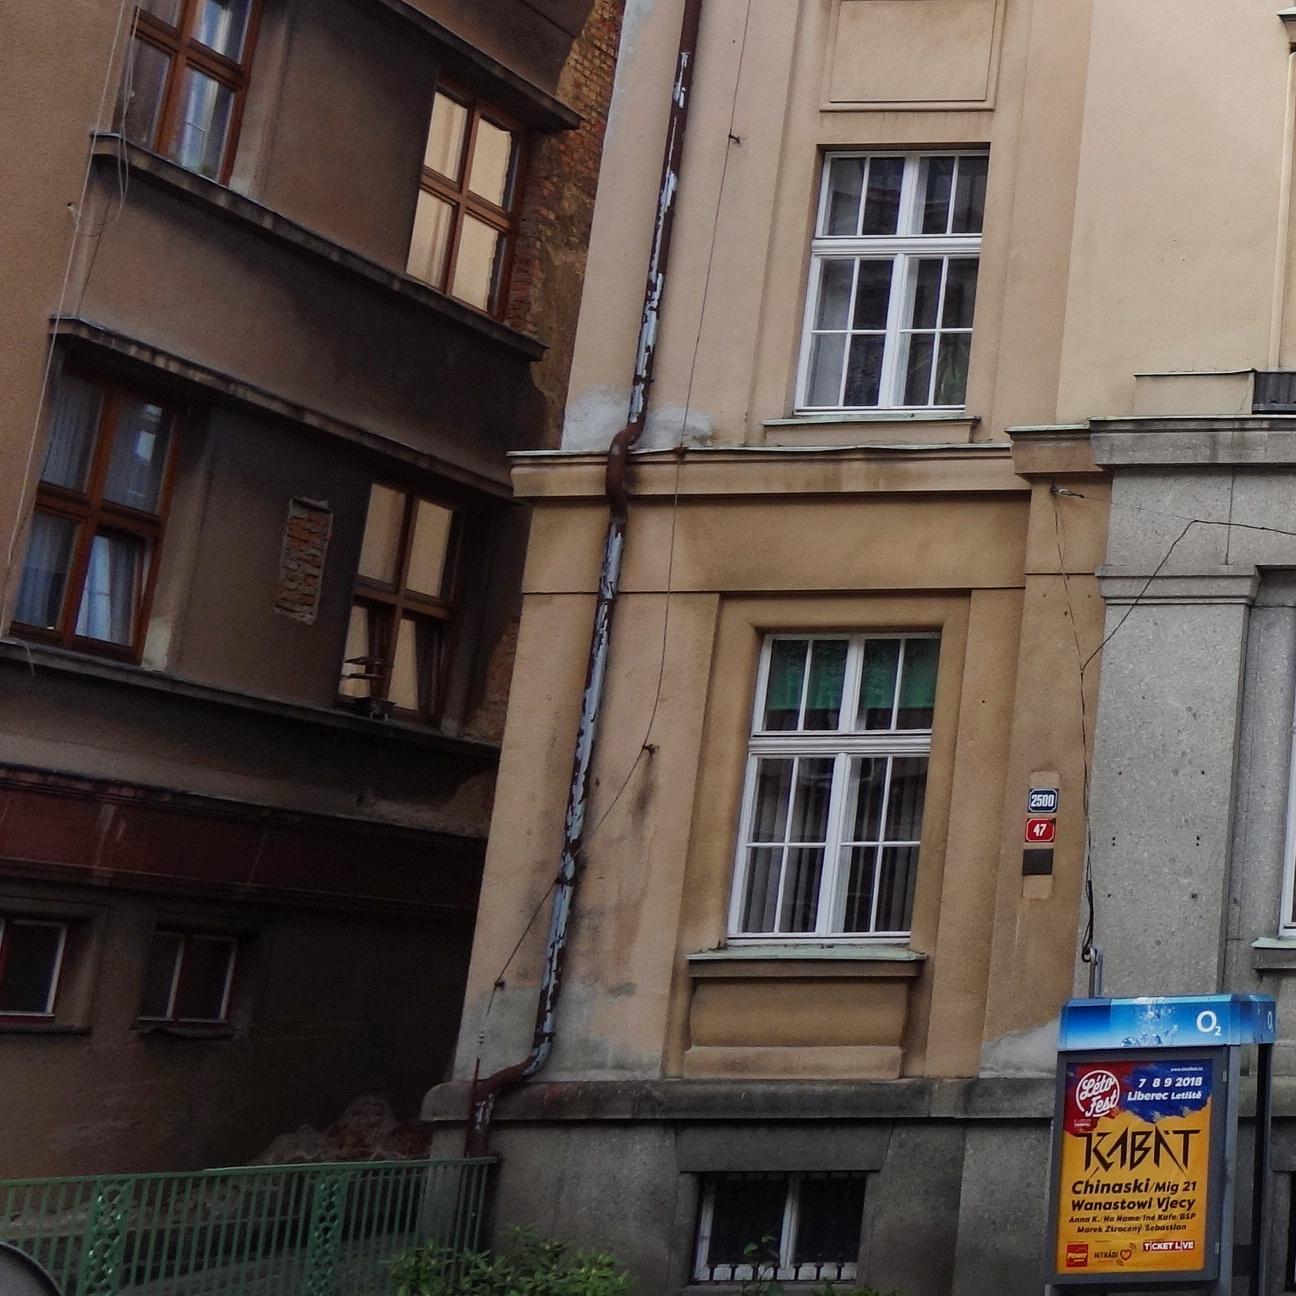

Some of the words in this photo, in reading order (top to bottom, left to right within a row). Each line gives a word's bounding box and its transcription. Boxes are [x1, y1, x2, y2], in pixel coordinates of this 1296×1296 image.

[1030, 794, 1054, 807] 2500
[1033, 823, 1047, 837] 47
[1196, 1010, 1222, 1037] O2
[1080, 1075, 1116, 1100] Léto
[1175, 1076, 1203, 1087] 2018
[1127, 1091, 1169, 1101] Liberec
[1085, 1089, 1117, 1117] Fest
[1182, 1180, 1197, 1192] 21
[1071, 1197, 1153, 1211] Wanastowi
[1156, 1197, 1196, 1212] Vjecy
[1076, 1225, 1103, 1233] Marek
